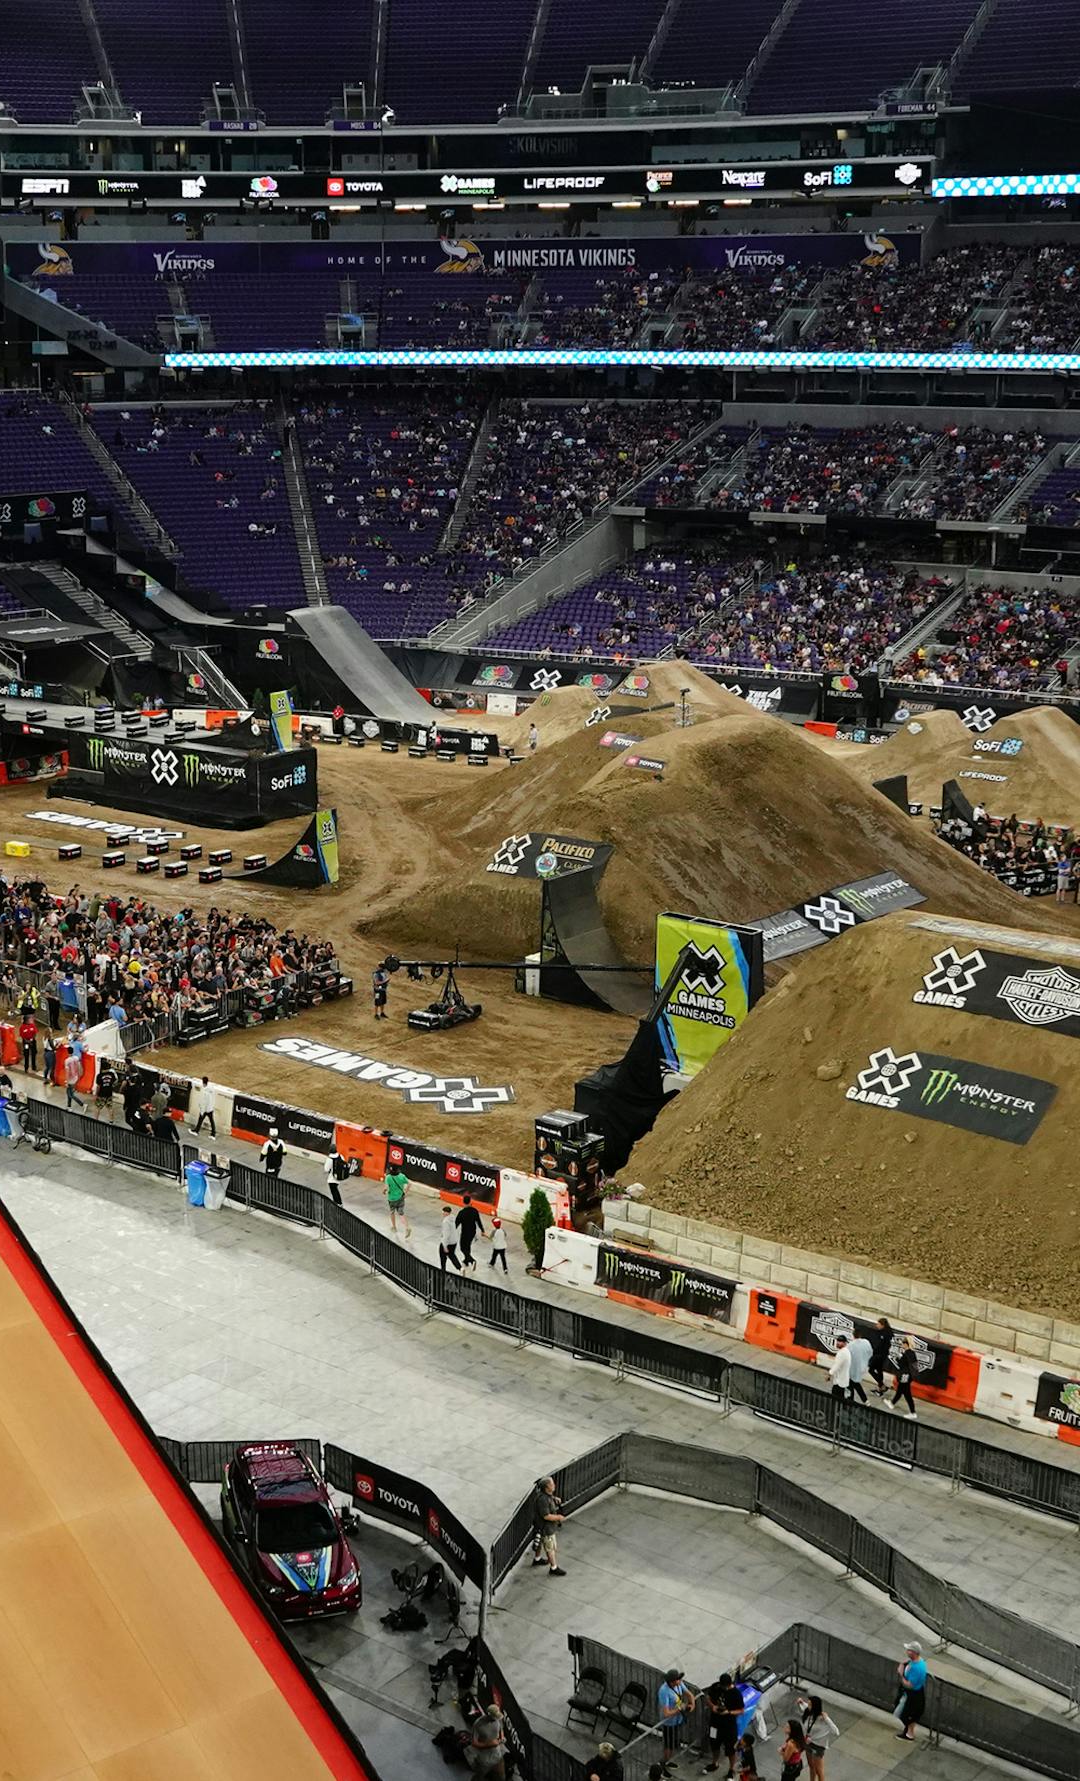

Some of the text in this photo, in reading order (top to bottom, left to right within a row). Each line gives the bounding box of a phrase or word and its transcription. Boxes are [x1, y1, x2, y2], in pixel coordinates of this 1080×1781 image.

[22, 178, 70, 193] ESPN
[345, 181, 384, 192] TOYOTA
[457, 178, 496, 189] GAMES
[524, 177, 605, 190] LIFEPROOF
[804, 171, 833, 186] SoFi
[327, 256, 427, 264] HOME OF THE
[493, 248, 636, 267] MINNESOTA VIKINGS
[899, 700, 934, 711] PACIFICO
[835, 731, 854, 740] SoFi
[103, 747, 148, 764] MONSTER
[973, 739, 1003, 753] SoFi
[199, 763, 247, 779] MONSTER
[959, 770, 1008, 782] LIFEPROOF
[271, 774, 293, 791] SoFi
[540, 837, 596, 859] PACIFICO
[486, 862, 520, 875] GAMES
[859, 879, 910, 898] MONSTER
[1030, 975, 1072, 991] MOTOR
[677, 991, 726, 1013] GAMES
[912, 990, 968, 1009] GAMES
[1018, 1000, 1058, 1018] CYCLES
[667, 1003, 736, 1028] MINNEAPOLIS
[261, 1037, 433, 1090] GAMES
[845, 1085, 901, 1109] GAMES
[952, 1081, 1036, 1113] MONSTER
[959, 1096, 1018, 1116] ENERGY
[235, 1104, 276, 1122] LIFEPROOF
[288, 1121, 332, 1140] LIFEPROOF
[405, 1153, 437, 1172] TOYOTA
[463, 1170, 497, 1189] TOYOTA
[619, 1260, 661, 1280] MONSTER
[685, 1278, 729, 1299] MONSTER
[1048, 1406, 1079, 1426] FRUIT
[377, 1487, 421, 1517] TOYOTA
[440, 1527, 467, 1561] TOYOTA
